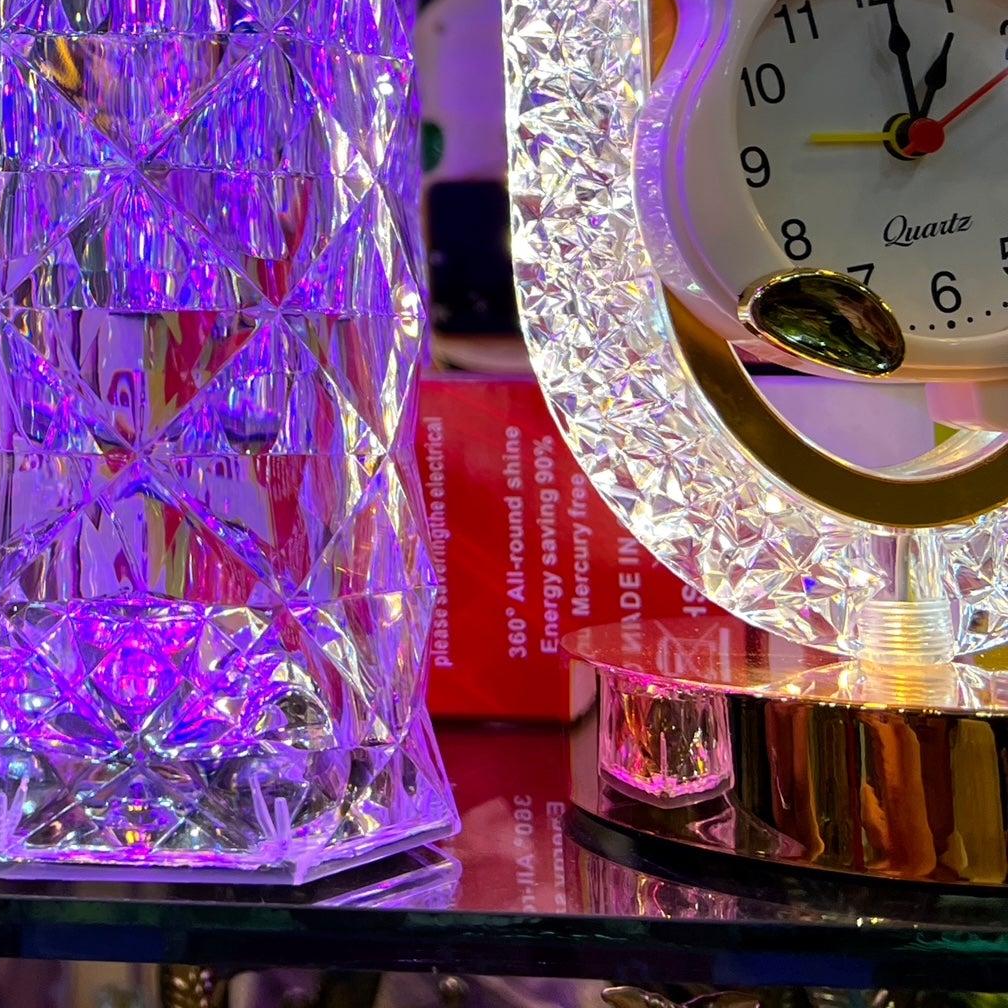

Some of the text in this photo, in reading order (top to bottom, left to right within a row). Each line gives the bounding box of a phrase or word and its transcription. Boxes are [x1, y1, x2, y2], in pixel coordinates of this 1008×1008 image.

[774, 0, 819, 43] 11
[740, 63, 786, 106] 10
[740, 146, 771, 188] 9
[781, 219, 812, 260] 8
[883, 213, 973, 247] Quartz
[931, 271, 962, 313] 6
[422, 416, 445, 498] electrical
[501, 425, 528, 658] 360° All-round shine
[532, 435, 563, 654] Energy saving 90%
[567, 473, 592, 616] Mercury free
[617, 537, 640, 566] IN
[431, 608, 453, 666] please
